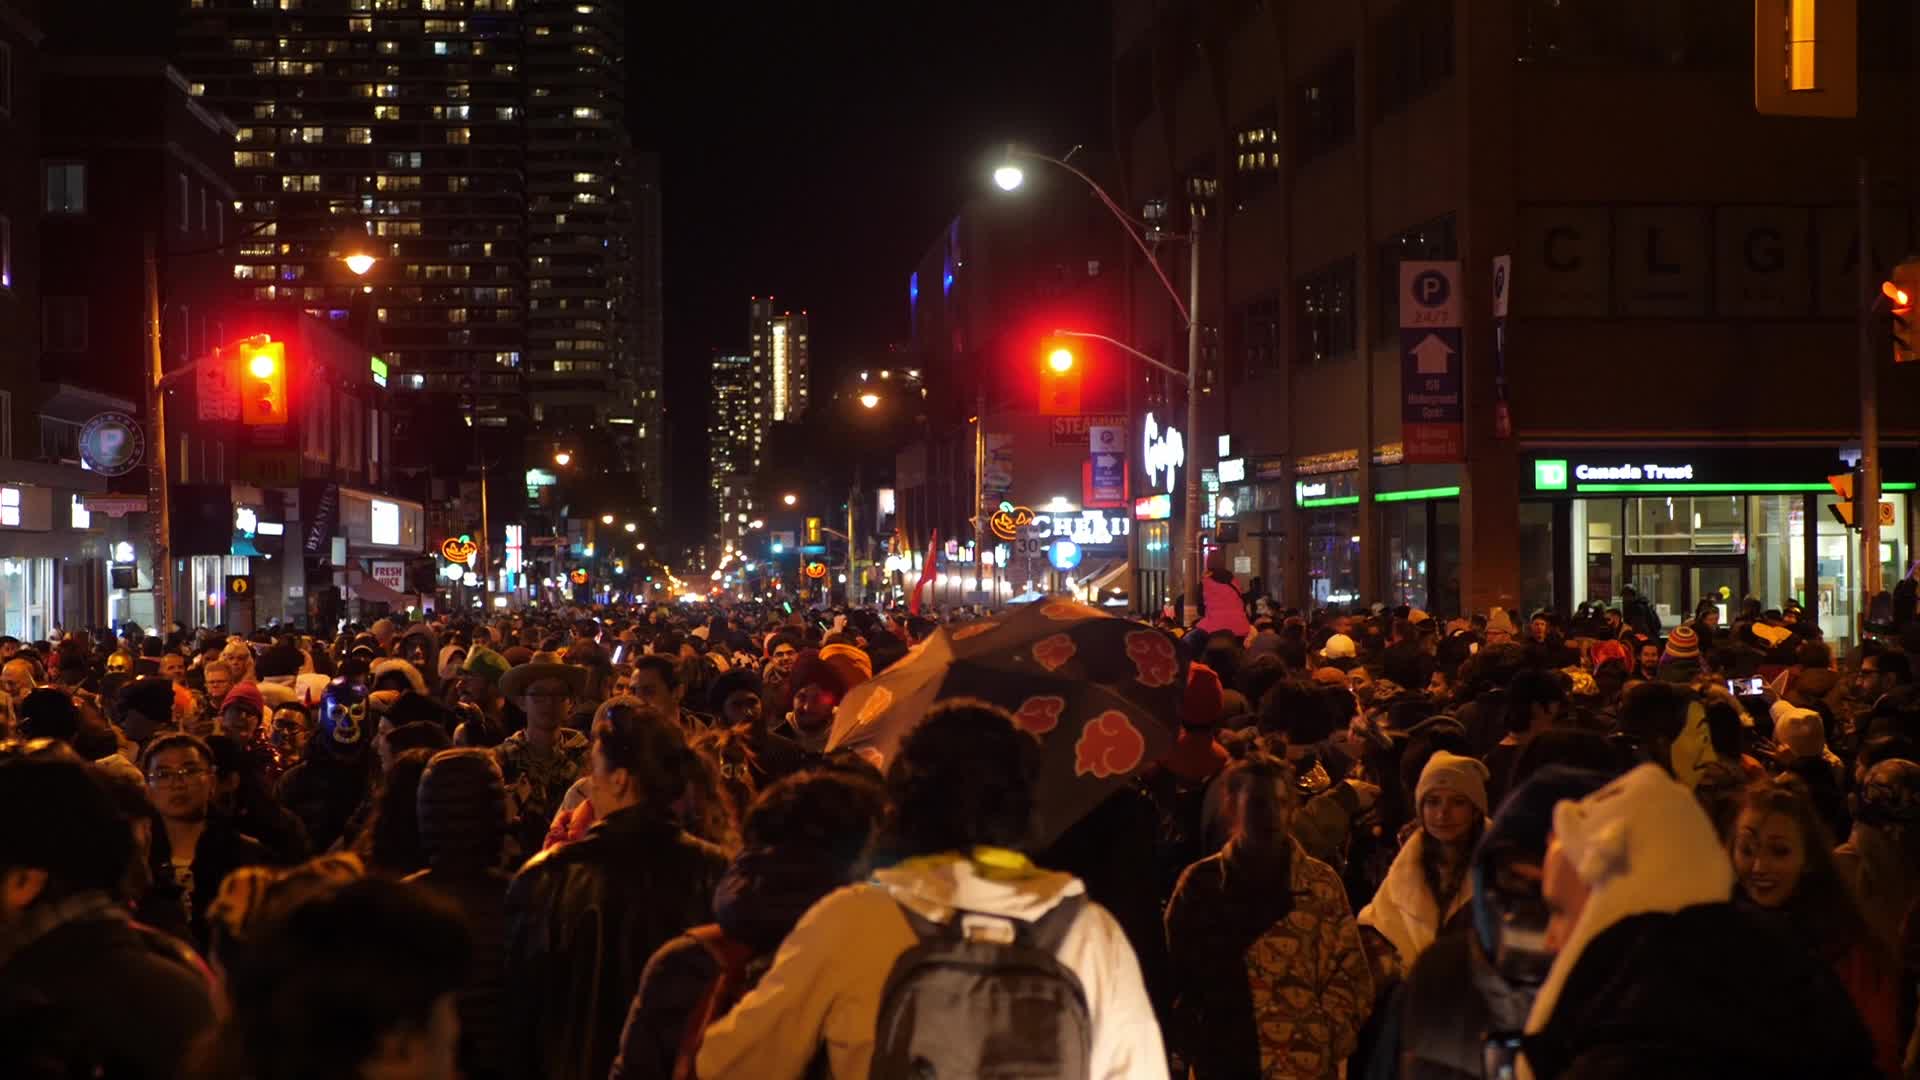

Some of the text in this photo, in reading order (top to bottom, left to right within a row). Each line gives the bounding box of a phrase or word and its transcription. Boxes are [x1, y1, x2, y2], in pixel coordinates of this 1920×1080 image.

[1542, 226, 1581, 272] C
[1645, 227, 1681, 274] L
[1744, 226, 1785, 273] G
[1423, 277, 1441, 301] P
[1537, 464, 1565, 485] TD
[1576, 464, 1693, 479] Canada Trust
[1018, 538, 1038, 553] 30
[375, 567, 402, 577] FRESH
[379, 577, 401, 587] UICE
